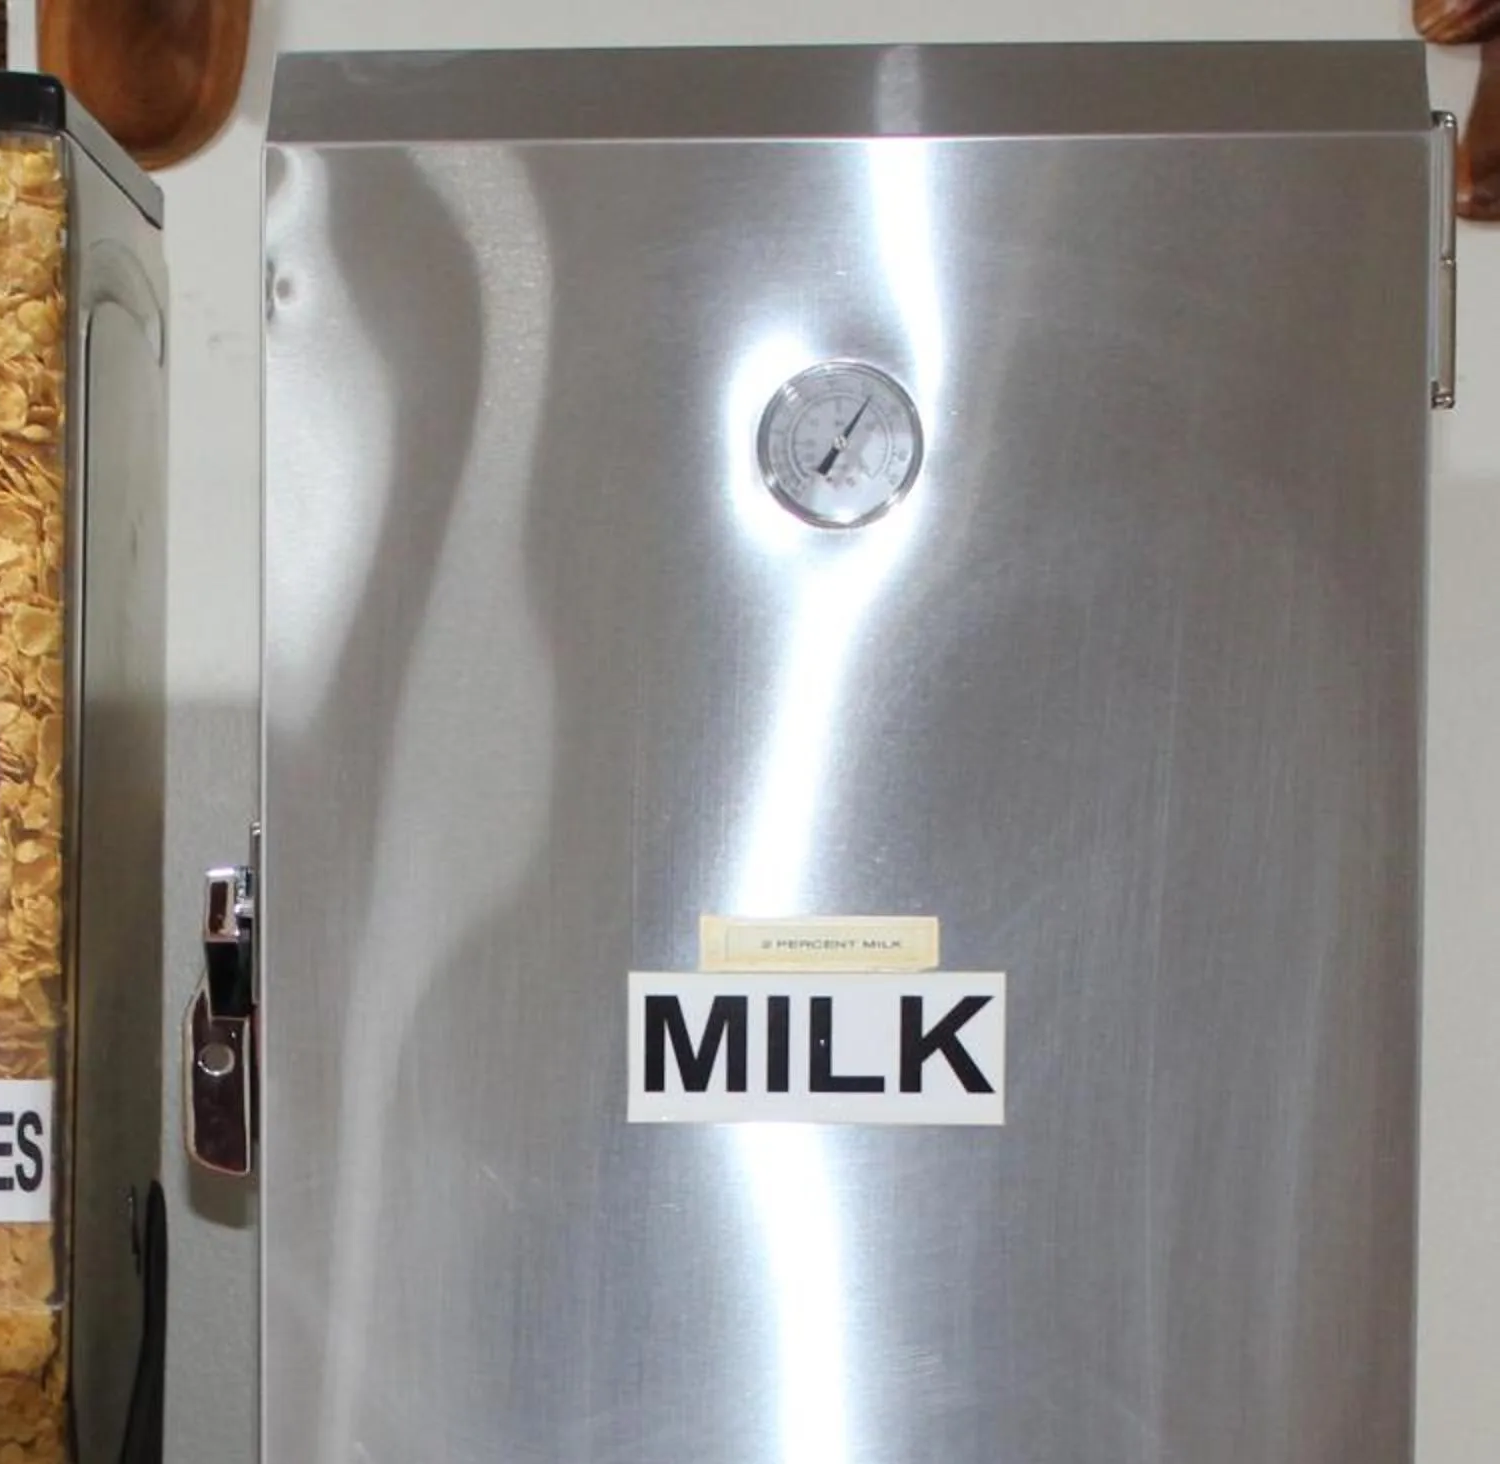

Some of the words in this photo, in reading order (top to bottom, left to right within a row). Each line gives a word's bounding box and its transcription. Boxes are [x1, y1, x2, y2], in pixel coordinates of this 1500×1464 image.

[776, 939, 856, 950] PERCENT
[862, 939, 902, 950] MILK
[644, 995, 996, 1094] MILK
